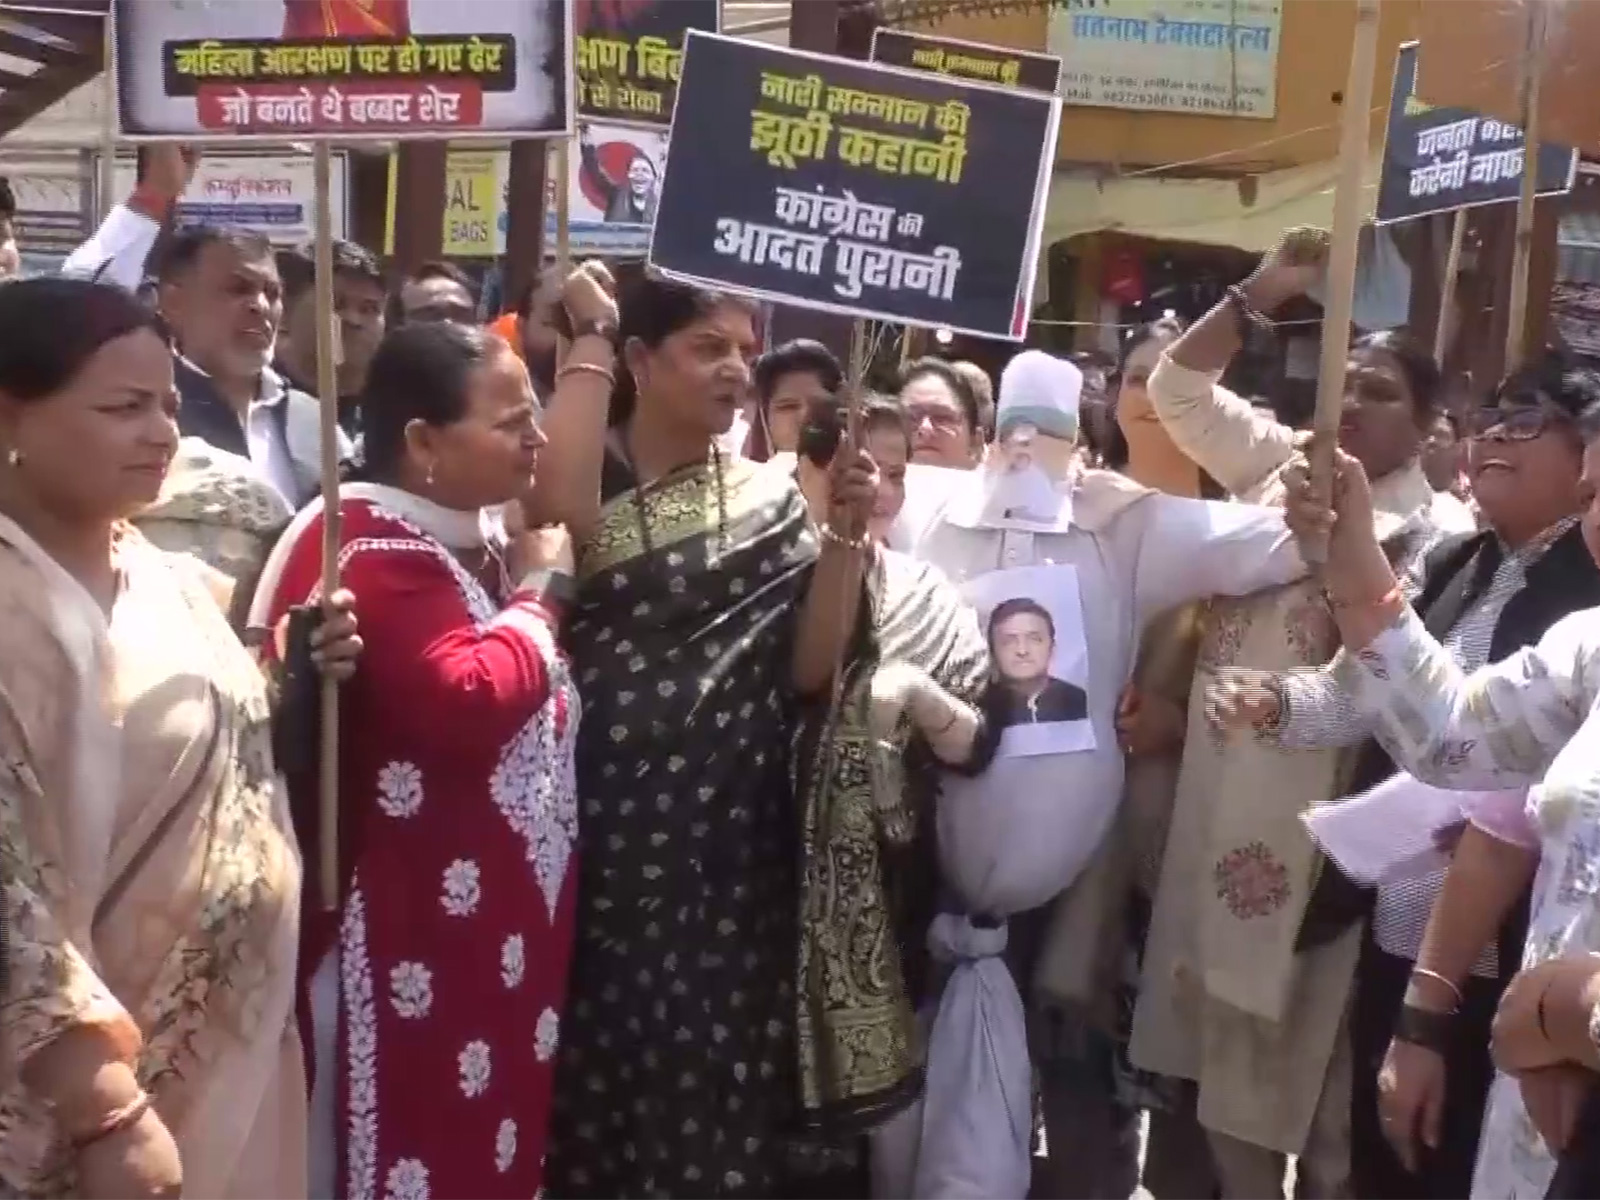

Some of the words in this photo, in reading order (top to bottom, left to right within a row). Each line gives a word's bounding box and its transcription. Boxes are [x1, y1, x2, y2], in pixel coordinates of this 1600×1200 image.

[174, 40, 254, 75] महिला
[261, 46, 351, 75] आरक्षण
[356, 45, 390, 73] पर
[393, 37, 421, 73] हो
[424, 43, 463, 73] गए
[466, 35, 503, 72] ढेर
[217, 87, 250, 125] जो
[255, 87, 316, 124] बनते
[321, 86, 346, 122] थे
[347, 93, 413, 123] बब्बर
[418, 85, 462, 122] शेर
[760, 71, 823, 108] नारी
[826, 85, 929, 130] सम्मान
[934, 99, 971, 135] की
[750, 109, 832, 169] झूठी
[838, 125, 968, 184] कहानी
[450, 220, 489, 243] BAGS
[775, 184, 895, 241] कांग्रेस
[898, 212, 924, 238] की
[713, 217, 828, 275] आदत
[834, 245, 962, 300] पुरानी
